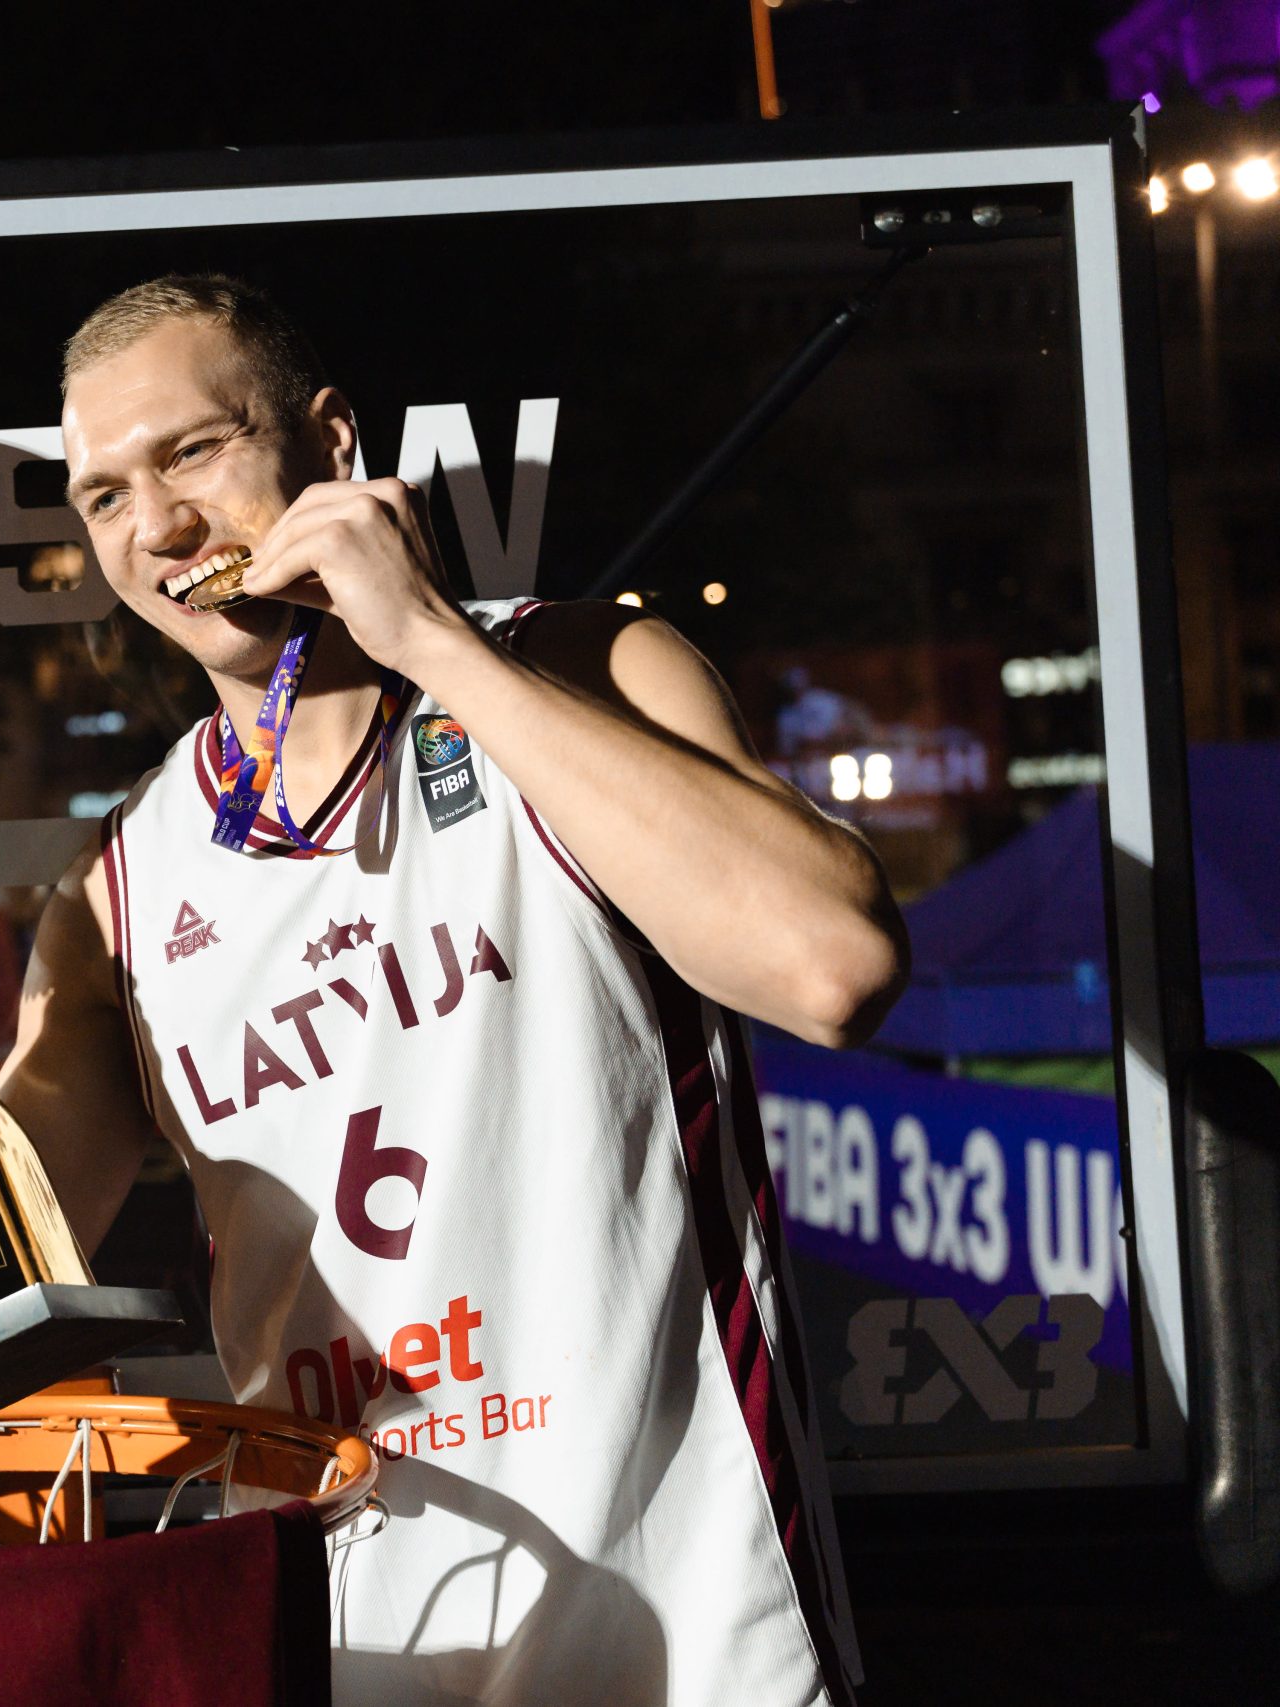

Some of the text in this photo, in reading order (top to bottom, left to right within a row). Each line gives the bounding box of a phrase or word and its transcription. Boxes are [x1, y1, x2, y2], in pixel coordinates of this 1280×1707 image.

[430, 769, 470, 801] FIBA
[446, 811, 455, 819] Are
[164, 920, 222, 964] PEAK
[335, 1105, 429, 1261] 6
[759, 1091, 1129, 1308] FIBA 3x3 W
[357, 1393, 553, 1462] orts Bar
